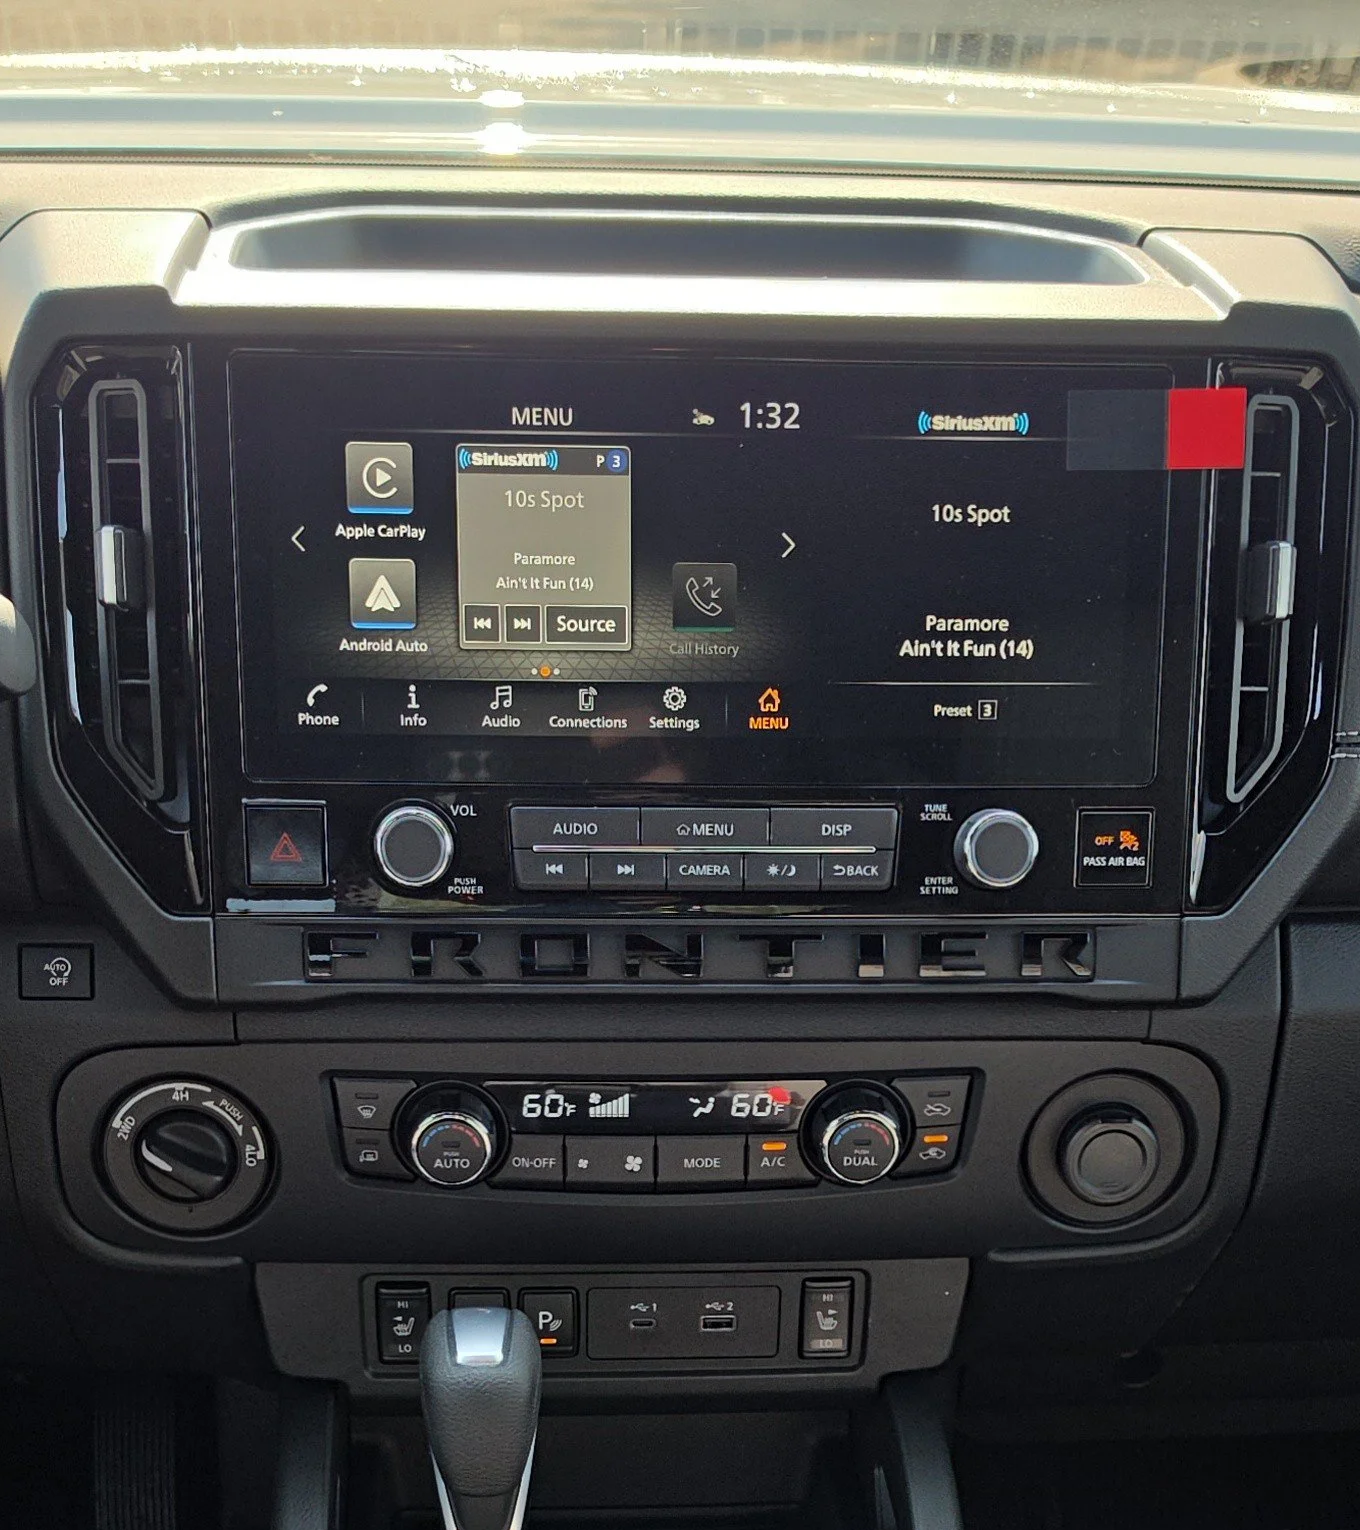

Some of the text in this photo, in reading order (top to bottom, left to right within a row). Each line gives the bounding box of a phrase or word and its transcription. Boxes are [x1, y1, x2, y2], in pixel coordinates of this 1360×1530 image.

[511, 406, 574, 427] MENU
[740, 402, 801, 430] 1:32
[596, 455, 622, 468] P 3
[504, 489, 585, 513] 10s Spot
[931, 503, 1011, 527] 10s Spot
[335, 523, 427, 542] Apple CarPlay
[513, 551, 576, 567] Paramore
[496, 575, 595, 592] Ain't It Fun (14)
[556, 615, 616, 634] Source
[925, 615, 1010, 632] Paramore
[339, 637, 429, 653] Android Auto
[669, 642, 740, 659] Call History
[899, 640, 1035, 660] Ain't It Fun (14)
[933, 703, 993, 718] Preset 3
[298, 711, 340, 727] Phone
[399, 712, 428, 728] Info
[481, 713, 521, 728] Audio
[548, 714, 628, 730] Connections
[648, 714, 700, 732] Settings
[749, 715, 790, 731] MENU
[449, 804, 478, 817] VOL
[924, 804, 949, 813] TUNE
[919, 812, 953, 822] SCROLL
[552, 822, 599, 837] AUDIO
[692, 823, 735, 837] MENU
[821, 823, 852, 837] DISP
[1095, 835, 1115, 846] OFF
[1083, 856, 1146, 867] PASS AIR BAG
[678, 864, 731, 877] CAMERA
[846, 864, 880, 878] BACK
[453, 877, 477, 886] PUSH
[924, 876, 954, 885] ENTER
[447, 885, 484, 895] POWER
[919, 885, 959, 895] SETTING
[304, 930, 1095, 981] FRONTIER
[44, 962, 66, 972] AUTO
[49, 977, 69, 986] OFF
[171, 1090, 190, 1101] 4H
[219, 1098, 244, 1121] PUSH
[117, 1115, 136, 1141] 2WD
[244, 1143, 257, 1167] 4LO
[760, 1156, 786, 1168] A/C
[843, 1156, 878, 1167] DUAL
[433, 1158, 470, 1169] AUTO
[511, 1157, 557, 1168] ON-OFF
[683, 1157, 721, 1168] MODE
[397, 1300, 409, 1309] HI
[652, 1302, 658, 1312] 1
[726, 1302, 734, 1311] 2
[398, 1343, 412, 1353] LO
